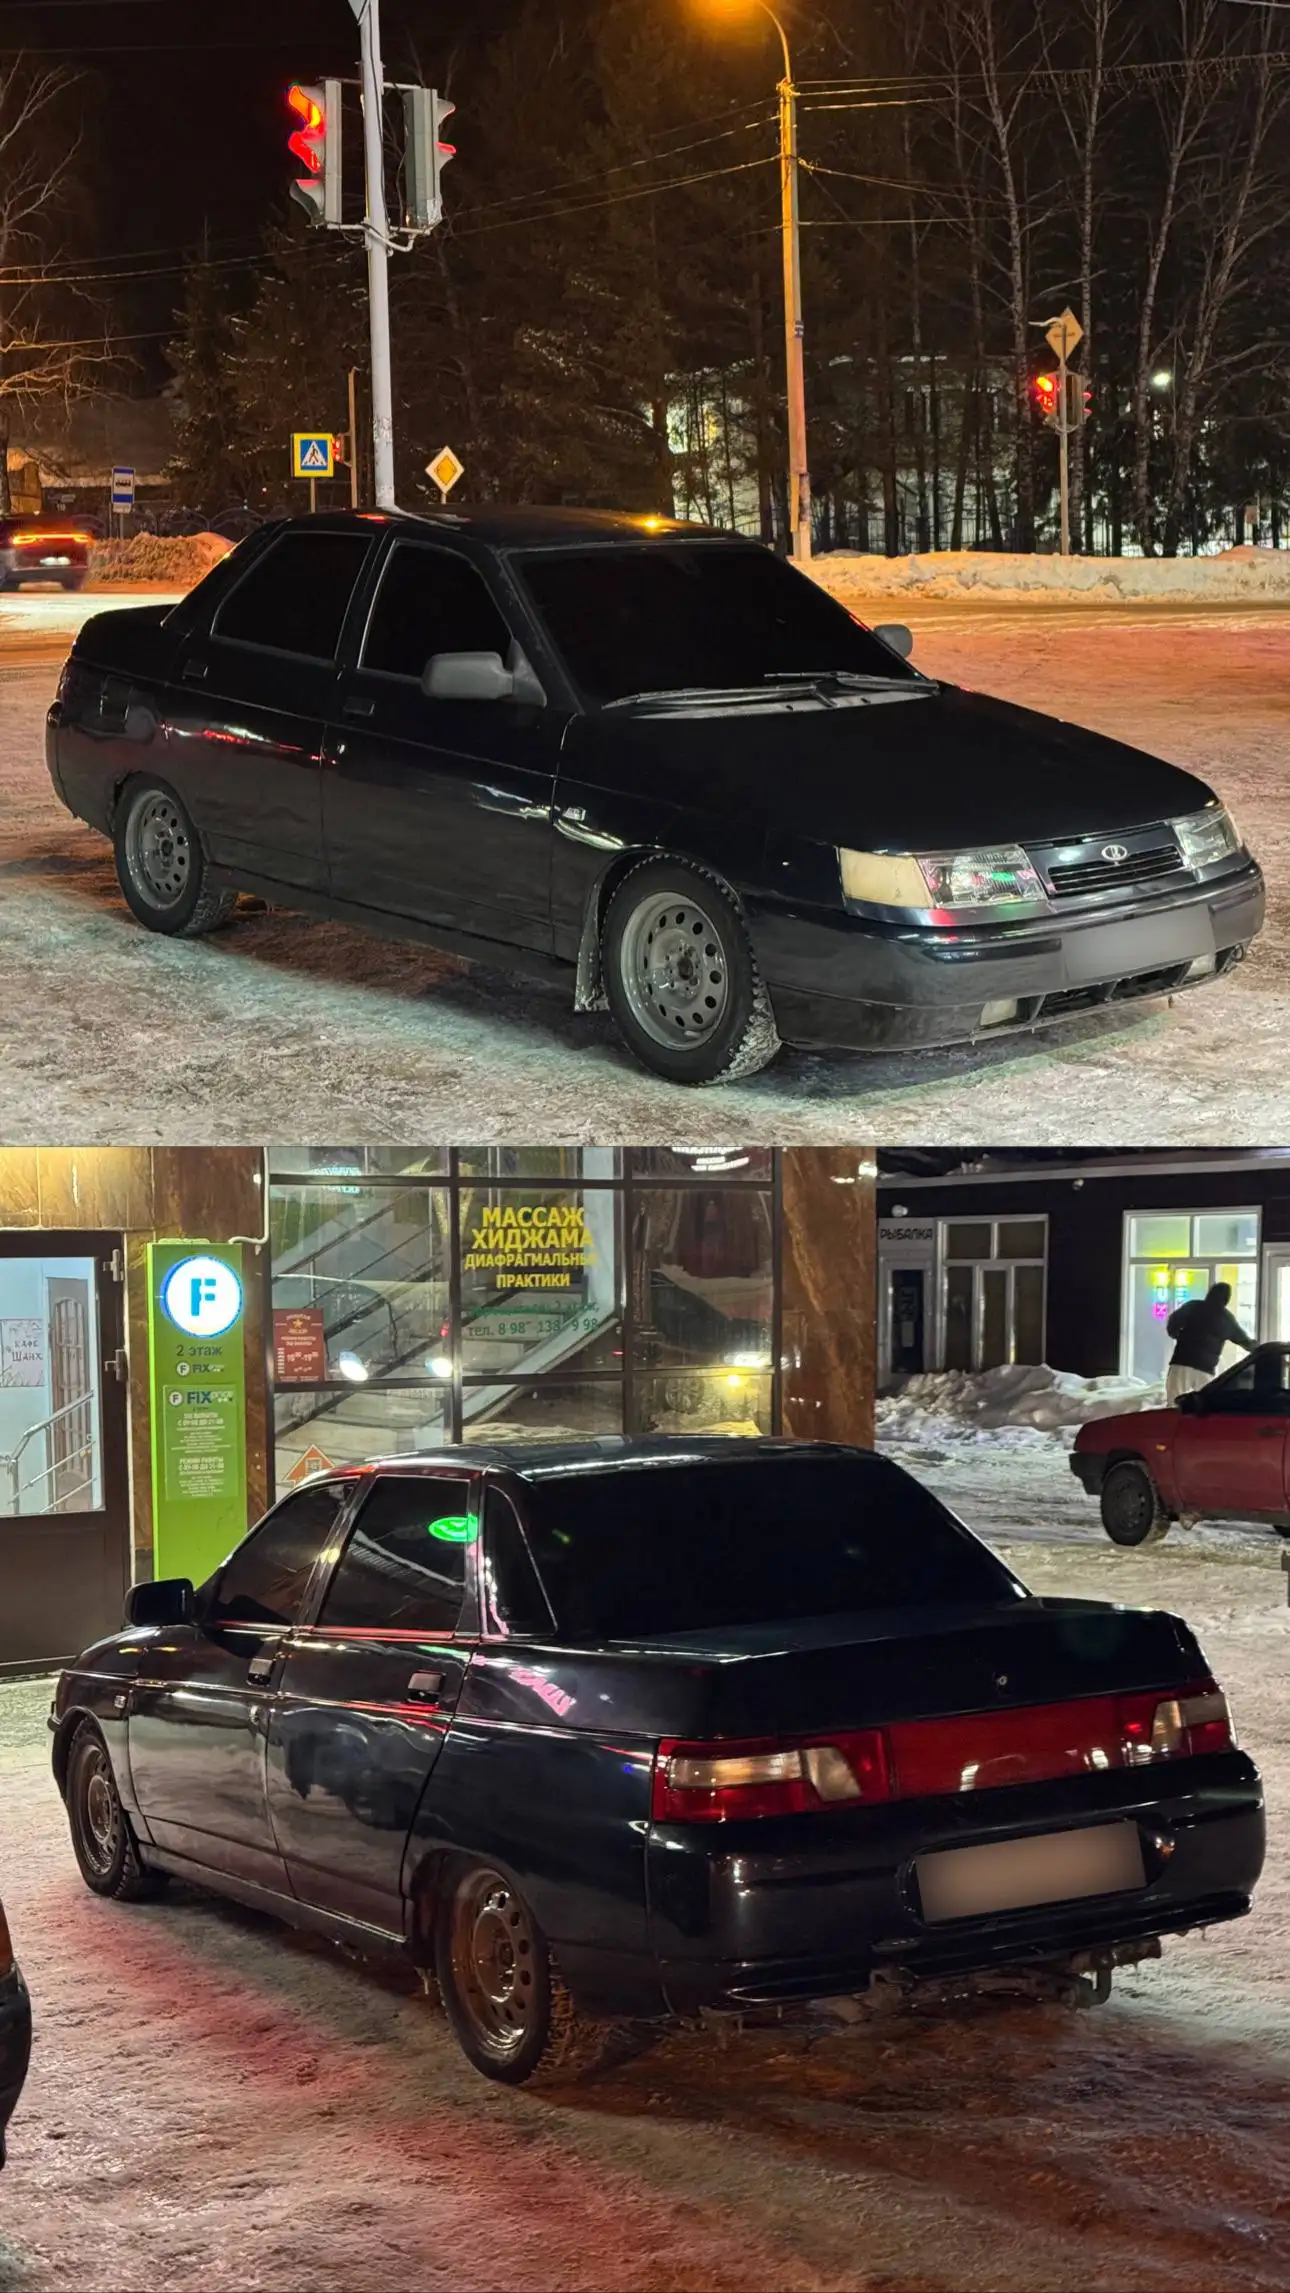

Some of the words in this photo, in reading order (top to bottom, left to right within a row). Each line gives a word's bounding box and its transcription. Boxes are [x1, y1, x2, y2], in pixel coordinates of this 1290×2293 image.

[482, 1207, 585, 1228] МАССАЖ
[471, 1229, 595, 1252] ХИДЖАМА
[880, 1228, 933, 1240] РЫБАЛКА
[496, 1273, 571, 1289] ПРАКТИКИ
[190, 1278, 217, 1317] F
[176, 1344, 184, 1357] 2
[188, 1346, 222, 1357] этаж
